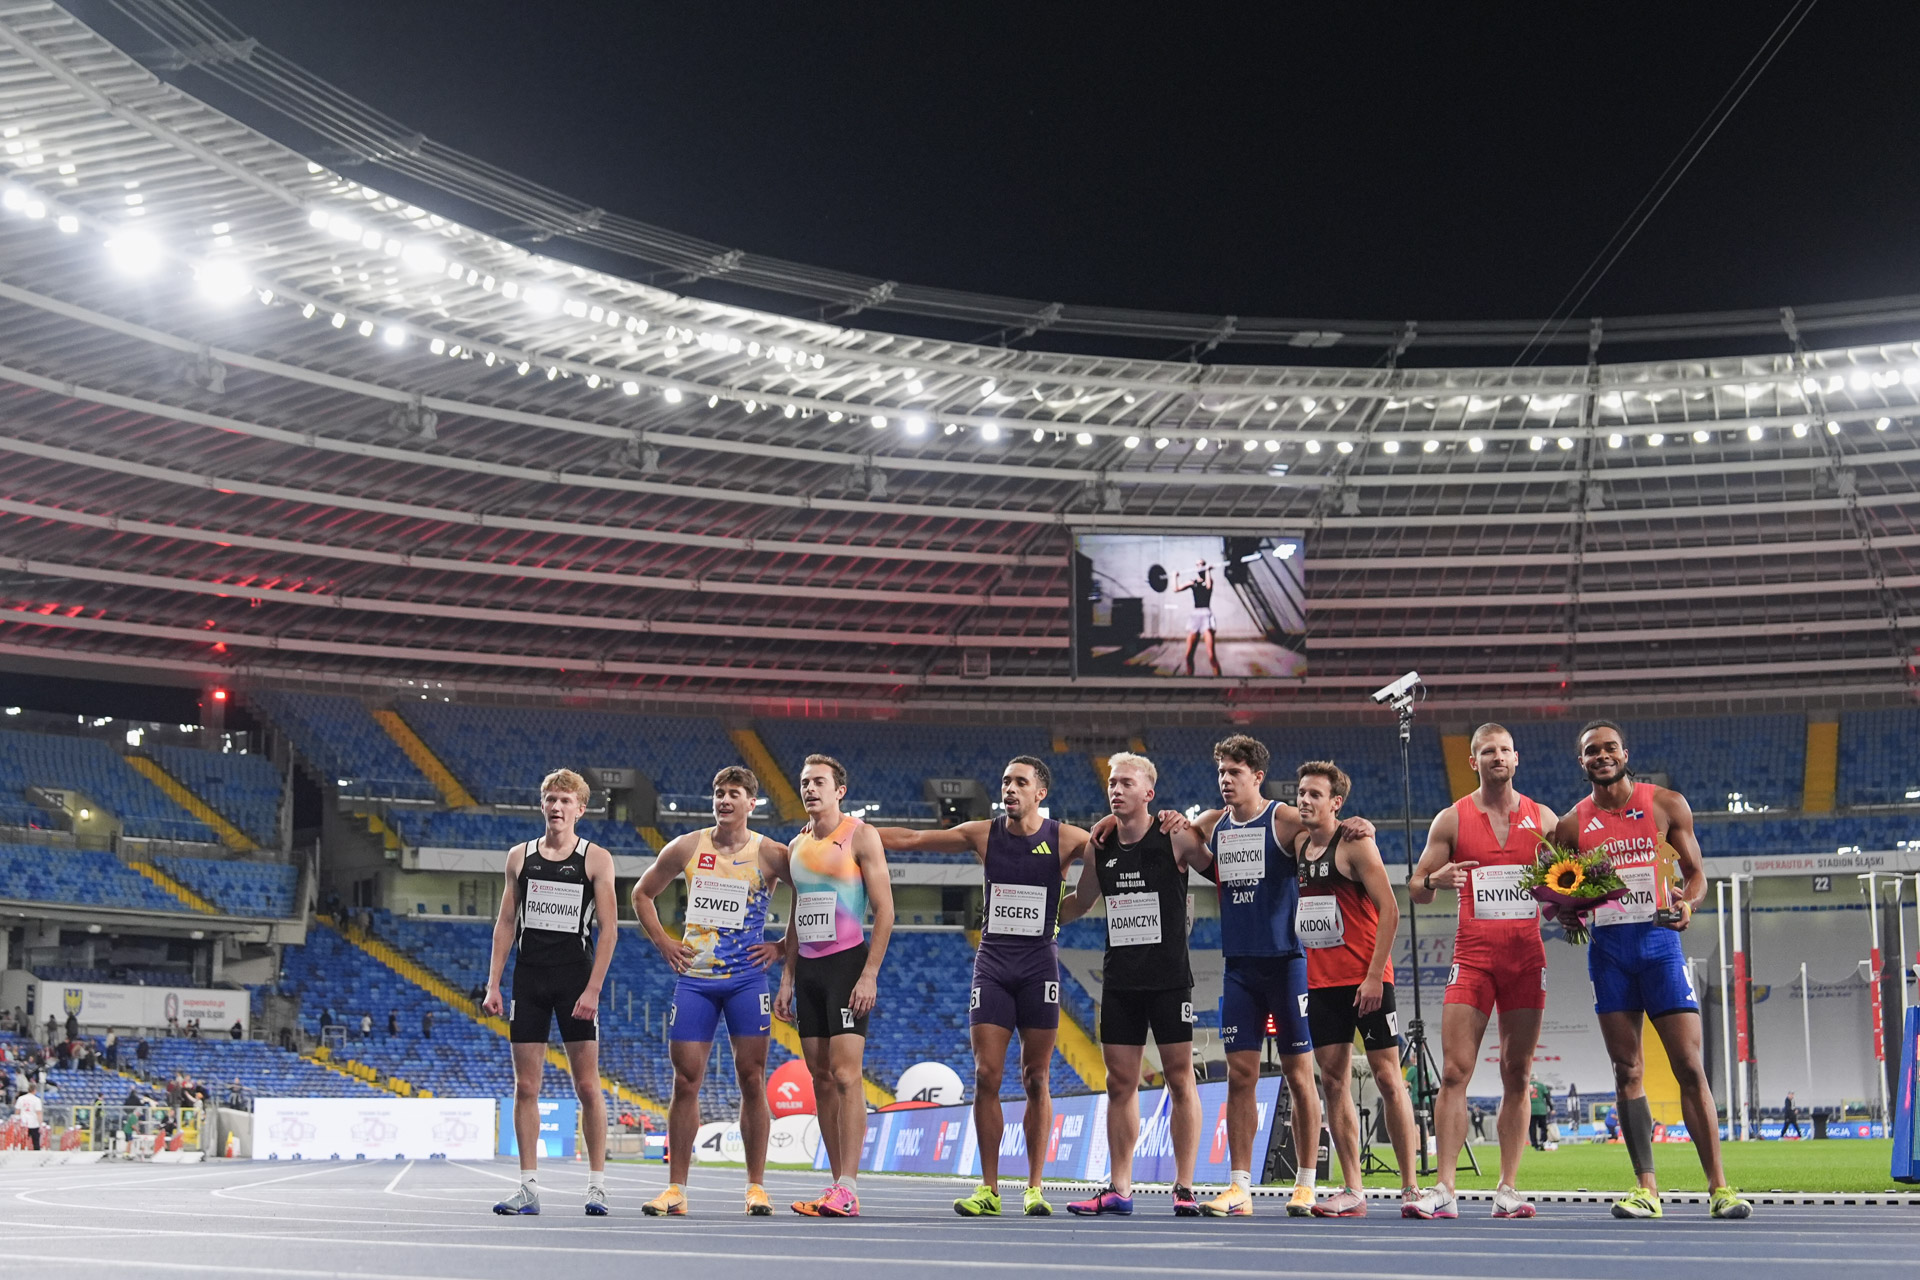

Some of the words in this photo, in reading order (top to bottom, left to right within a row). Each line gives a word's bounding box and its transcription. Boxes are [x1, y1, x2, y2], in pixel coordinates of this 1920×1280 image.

[1105, 858, 1118, 868] 4F
[1219, 848, 1262, 865] KIERNOŻYCKI
[1754, 860, 1814, 870] SUPERAUTO.PL
[1818, 858, 1853, 868] STADION
[1855, 856, 1885, 868] ŚLĄSKI
[1815, 877, 1829, 891] 22
[1232, 889, 1255, 904] ŻARY
[1620, 891, 1654, 905] ONTA
[527, 900, 579, 917] FRĄCKOWIAK
[694, 897, 739, 912] SZWED
[798, 913, 829, 927] SCOTTI
[995, 905, 1039, 920] SEGERS
[1111, 914, 1158, 930] ADAMCZYK
[1300, 916, 1331, 932] KIDOŃ
[971, 991, 977, 1007] 6
[1049, 984, 1057, 1001] 6
[764, 996, 769, 1012] 5
[1184, 1004, 1191, 1019] 9
[843, 1011, 850, 1024] 7
[1391, 1015, 1398, 1033] 1
[1221, 1026, 1238, 1034] ROS
[776, 1101, 803, 1109] ORLEN
